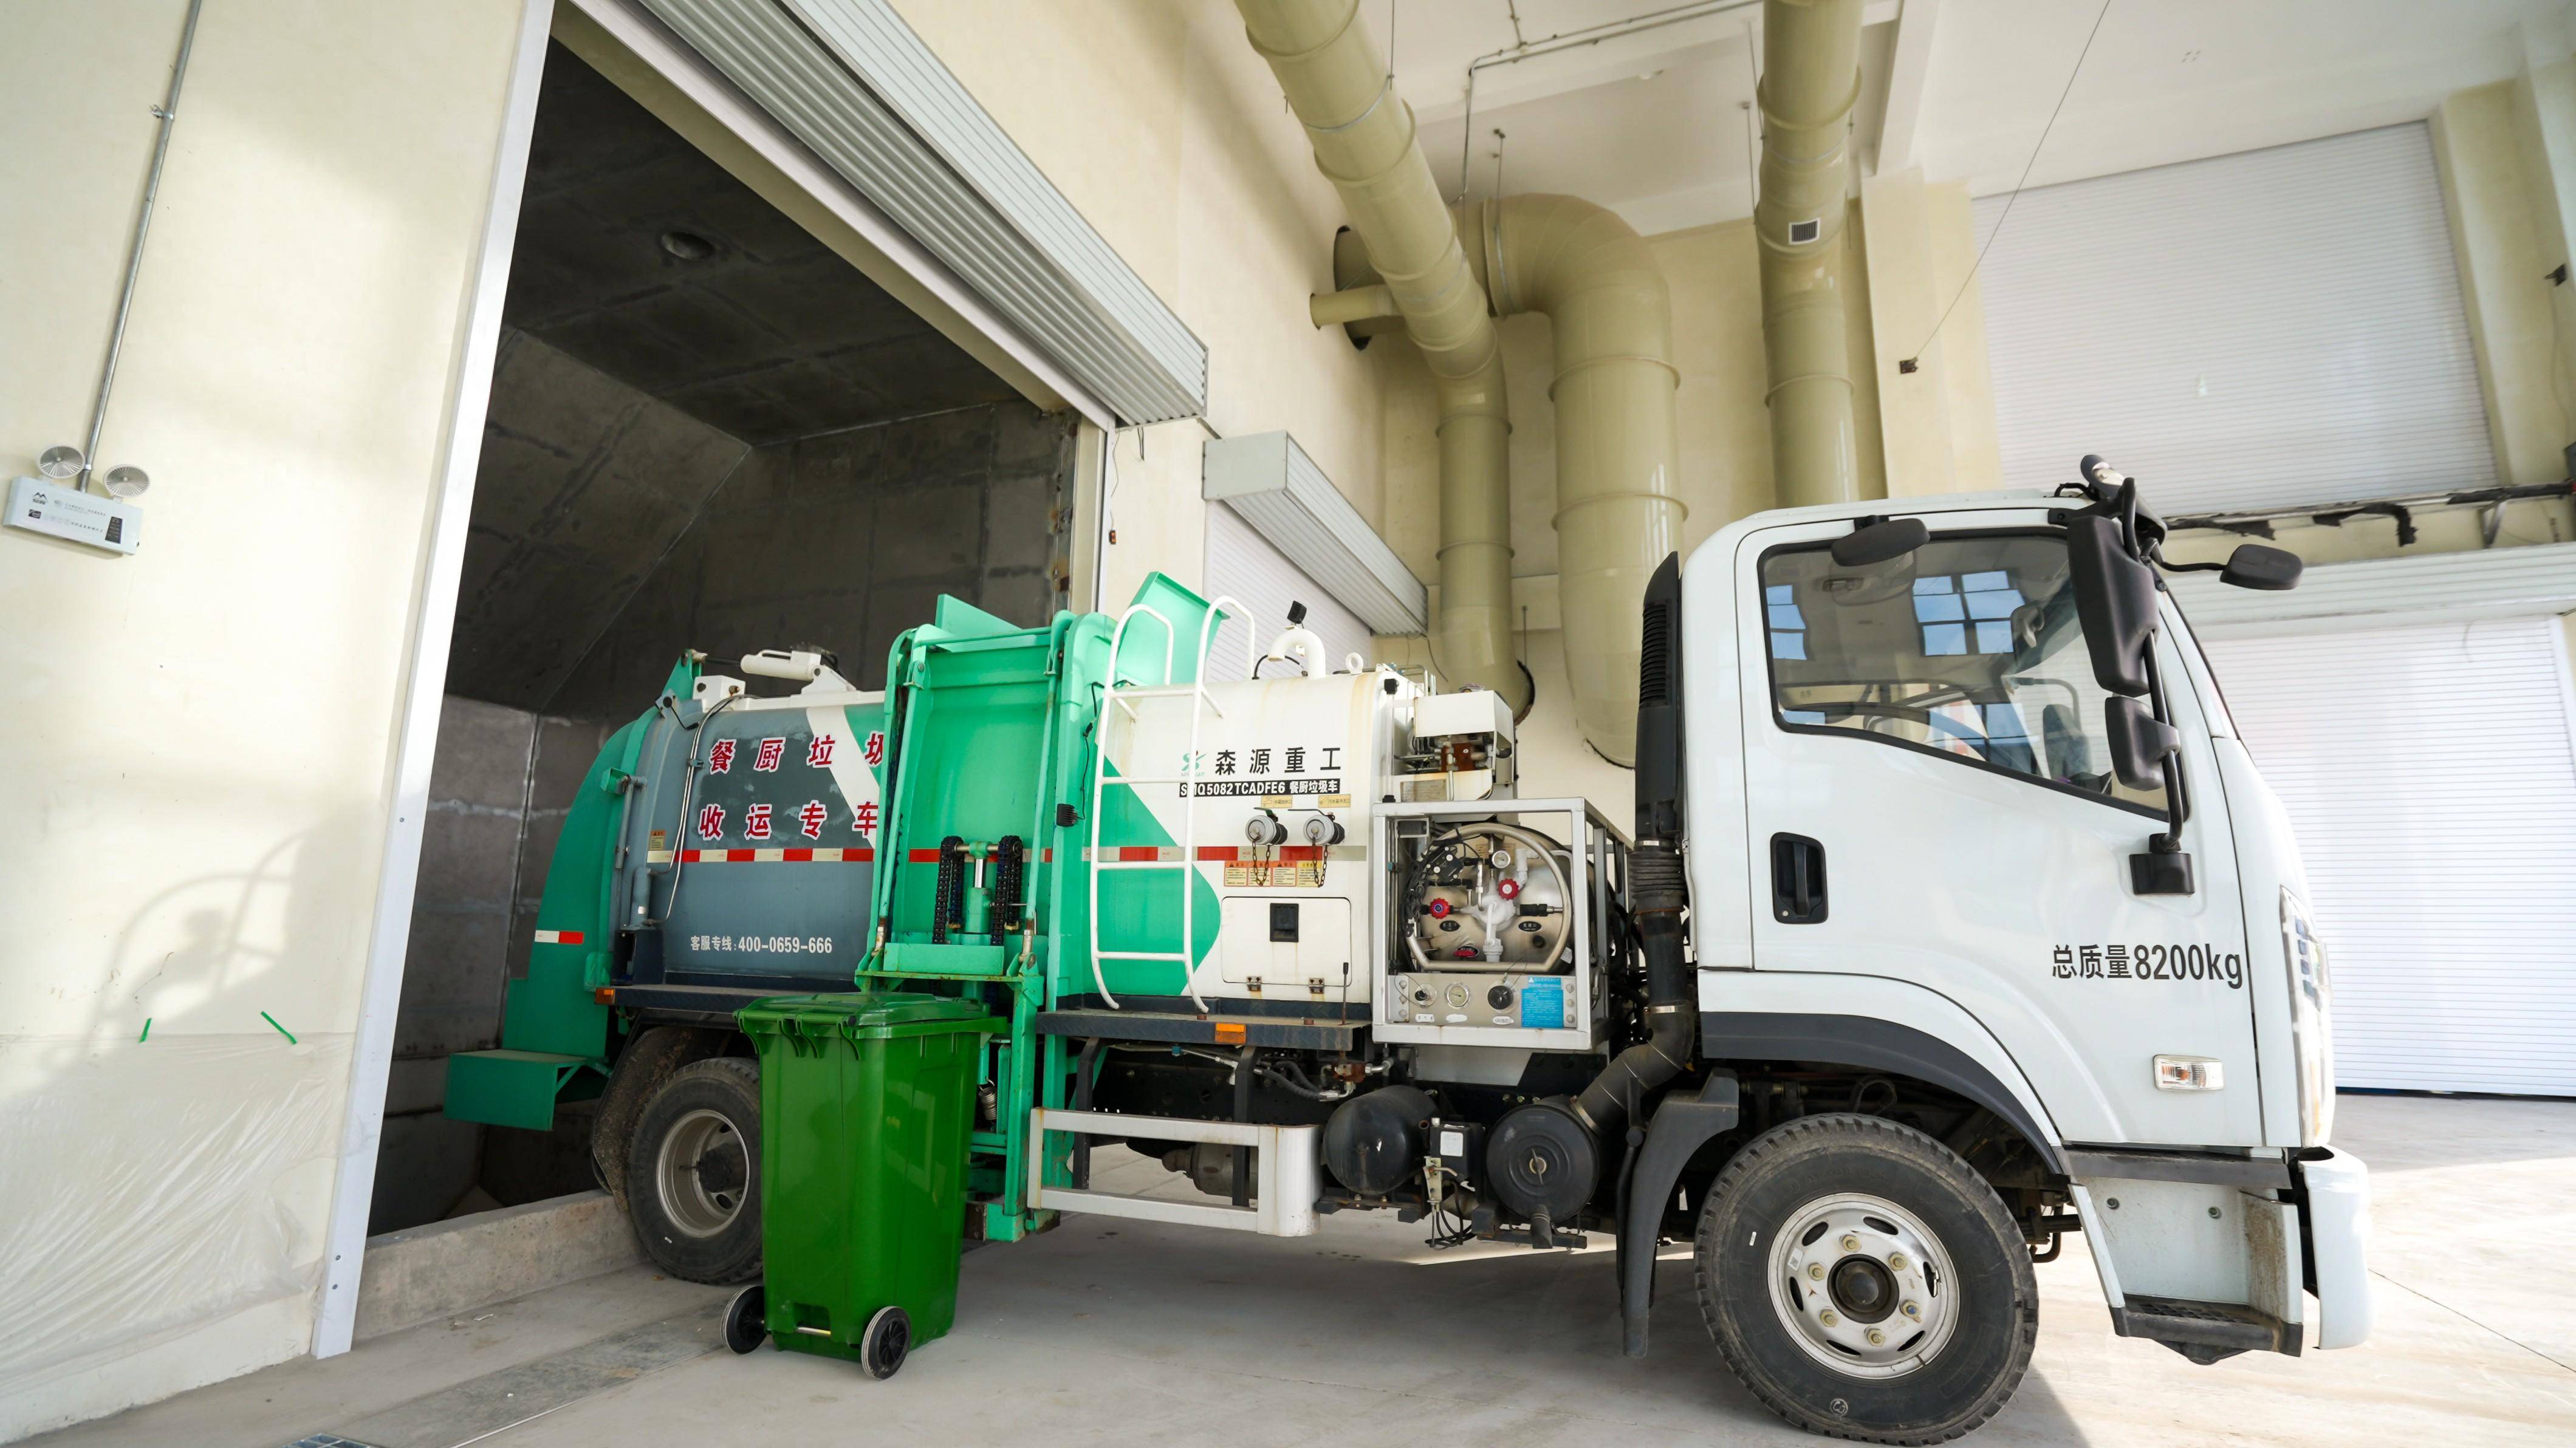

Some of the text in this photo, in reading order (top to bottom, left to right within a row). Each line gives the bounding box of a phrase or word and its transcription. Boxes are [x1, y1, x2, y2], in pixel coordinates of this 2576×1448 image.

[710, 733, 884, 773] 餐厨垃圾
[1215, 746, 1341, 776] 森源重工
[1180, 780, 1338, 796] SQ5082TCADFE6 餐厨垃圾车
[699, 801, 879, 839] 收运专车
[2052, 943, 2242, 989] 总质量8200kg
